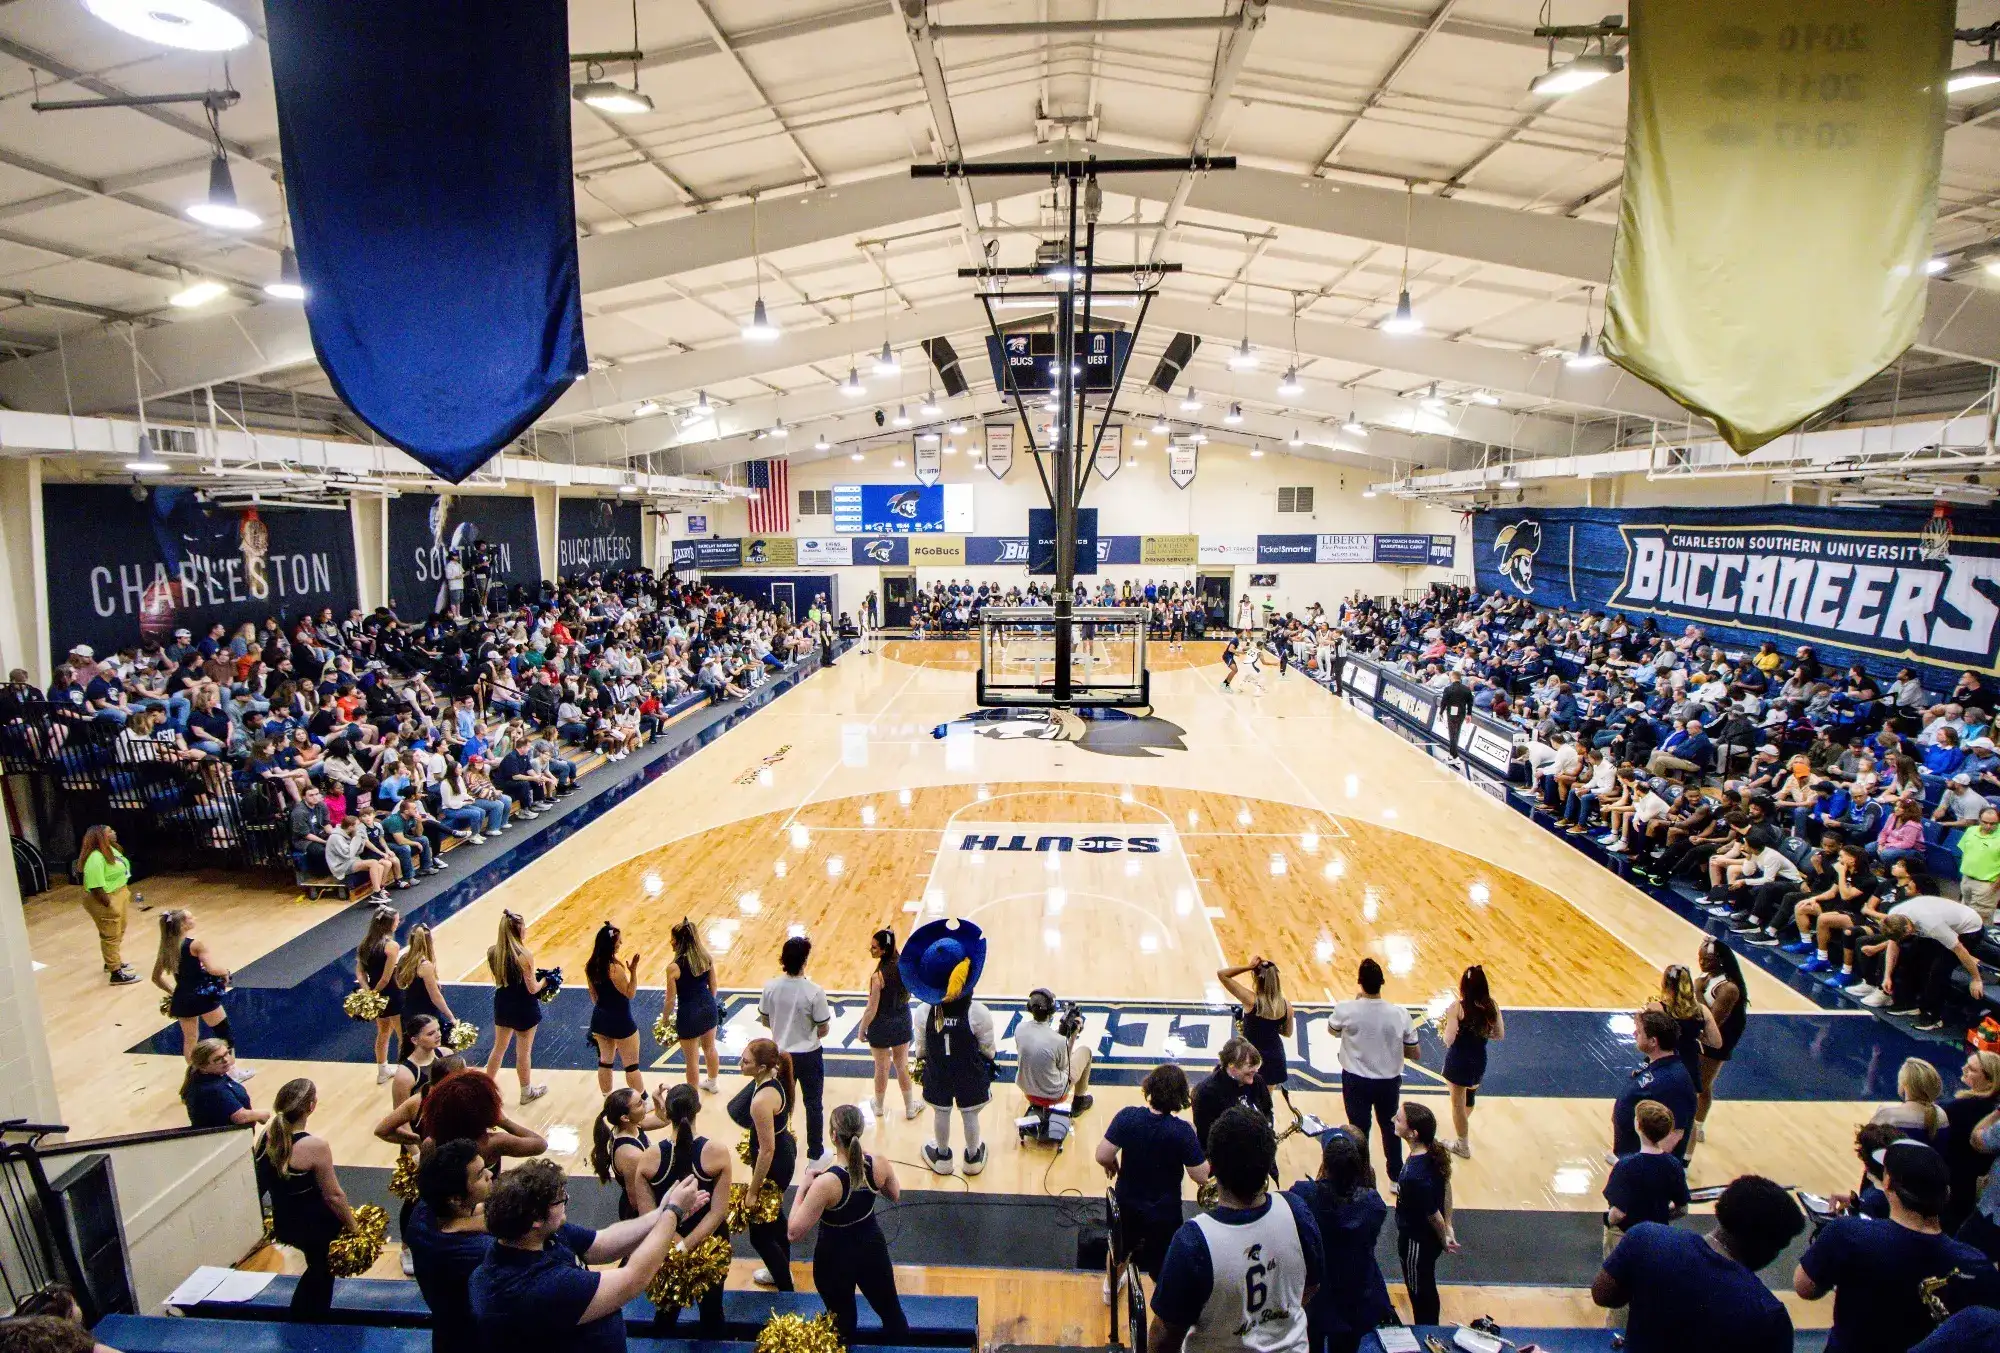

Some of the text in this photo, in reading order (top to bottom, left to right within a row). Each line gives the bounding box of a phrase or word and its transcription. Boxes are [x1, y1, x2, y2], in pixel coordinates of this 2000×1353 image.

[1010, 356, 1034, 366] BUCS
[1087, 355, 1108, 365] UEST
[1322, 535, 1369, 545] LIBERTY
[560, 536, 632, 567] BUCCANEERS
[914, 547, 960, 555] #GoBucs
[1259, 545, 1312, 554] TicketSmarter
[1672, 535, 1927, 562] CHARLESTON SOUTHERN UNIVERSITY
[90, 552, 331, 618] CHARLESTON
[157, 729, 176, 742] CSU
[943, 1033, 951, 1056] 1
[1245, 1263, 1268, 1313] 6
